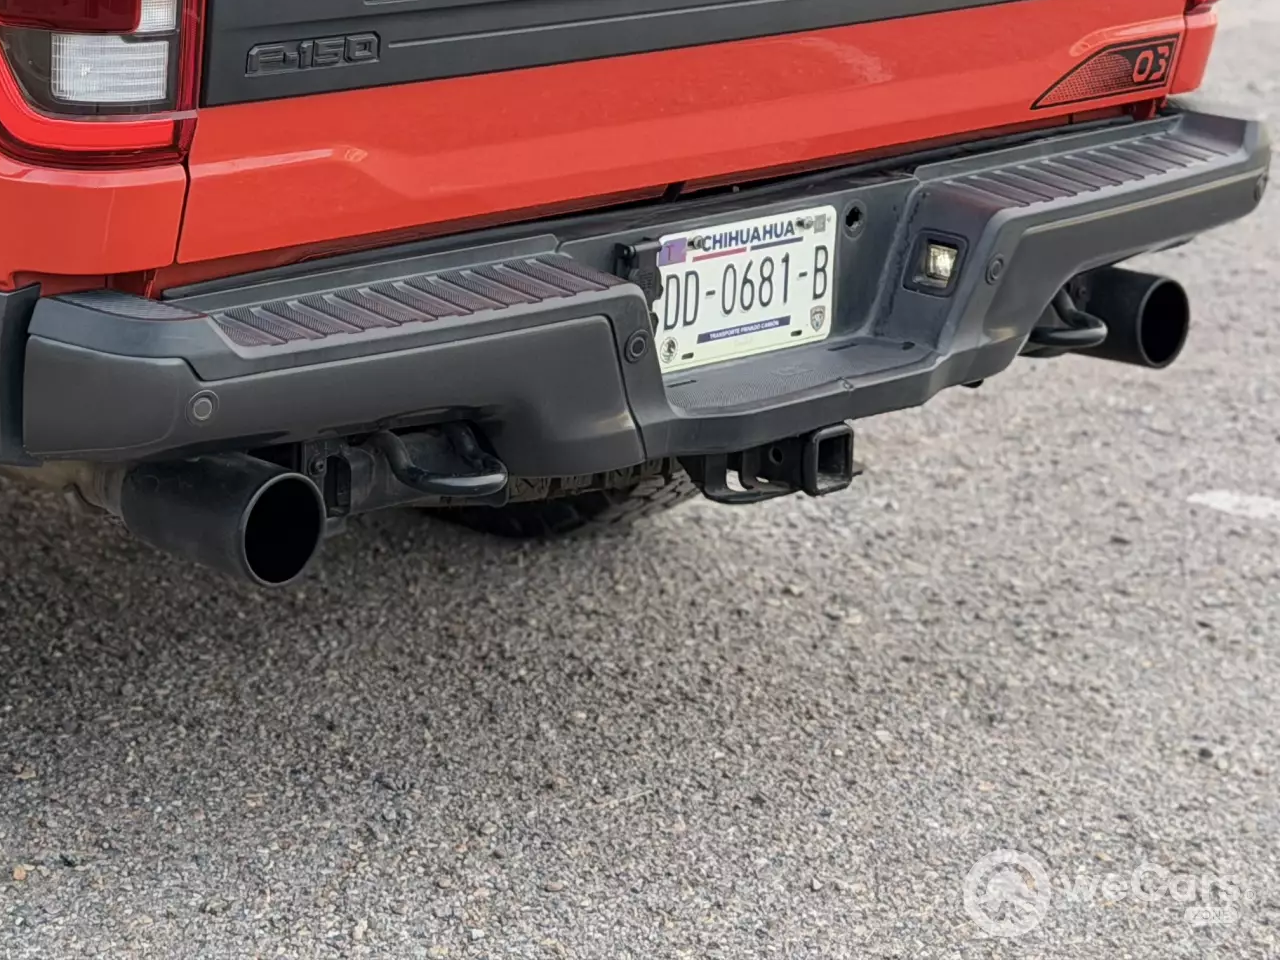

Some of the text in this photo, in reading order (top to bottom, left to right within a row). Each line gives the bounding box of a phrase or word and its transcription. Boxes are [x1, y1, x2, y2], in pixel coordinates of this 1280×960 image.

[245, 30, 381, 77] F-150
[1132, 46, 1170, 83] 03
[702, 220, 795, 252] CHIHUAHUA
[663, 245, 829, 331] DD-0681-B
